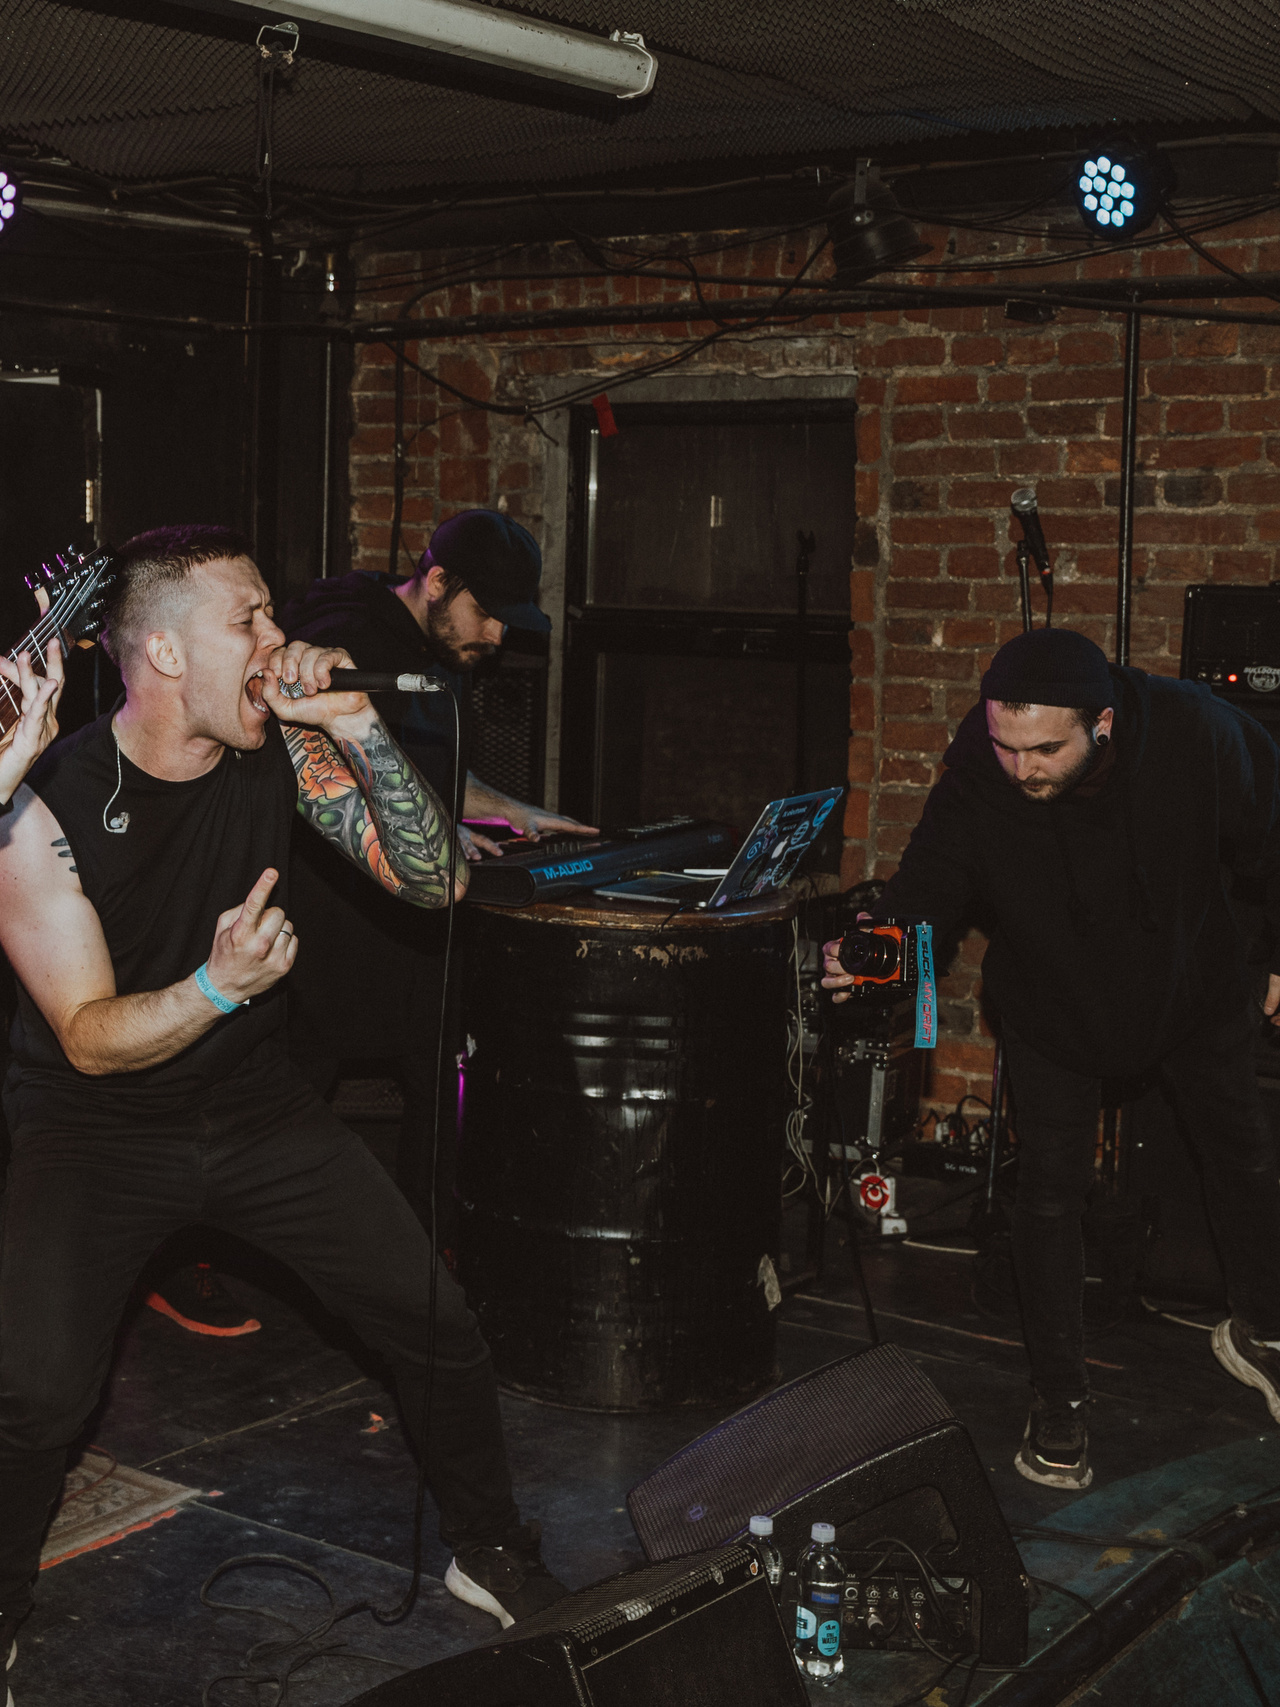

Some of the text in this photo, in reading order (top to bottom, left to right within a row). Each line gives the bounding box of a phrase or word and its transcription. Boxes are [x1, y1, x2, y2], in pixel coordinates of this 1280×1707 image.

[544, 860, 593, 880] M-AUDIO
[921, 940, 933, 1043] SUCK MY DRIFT
